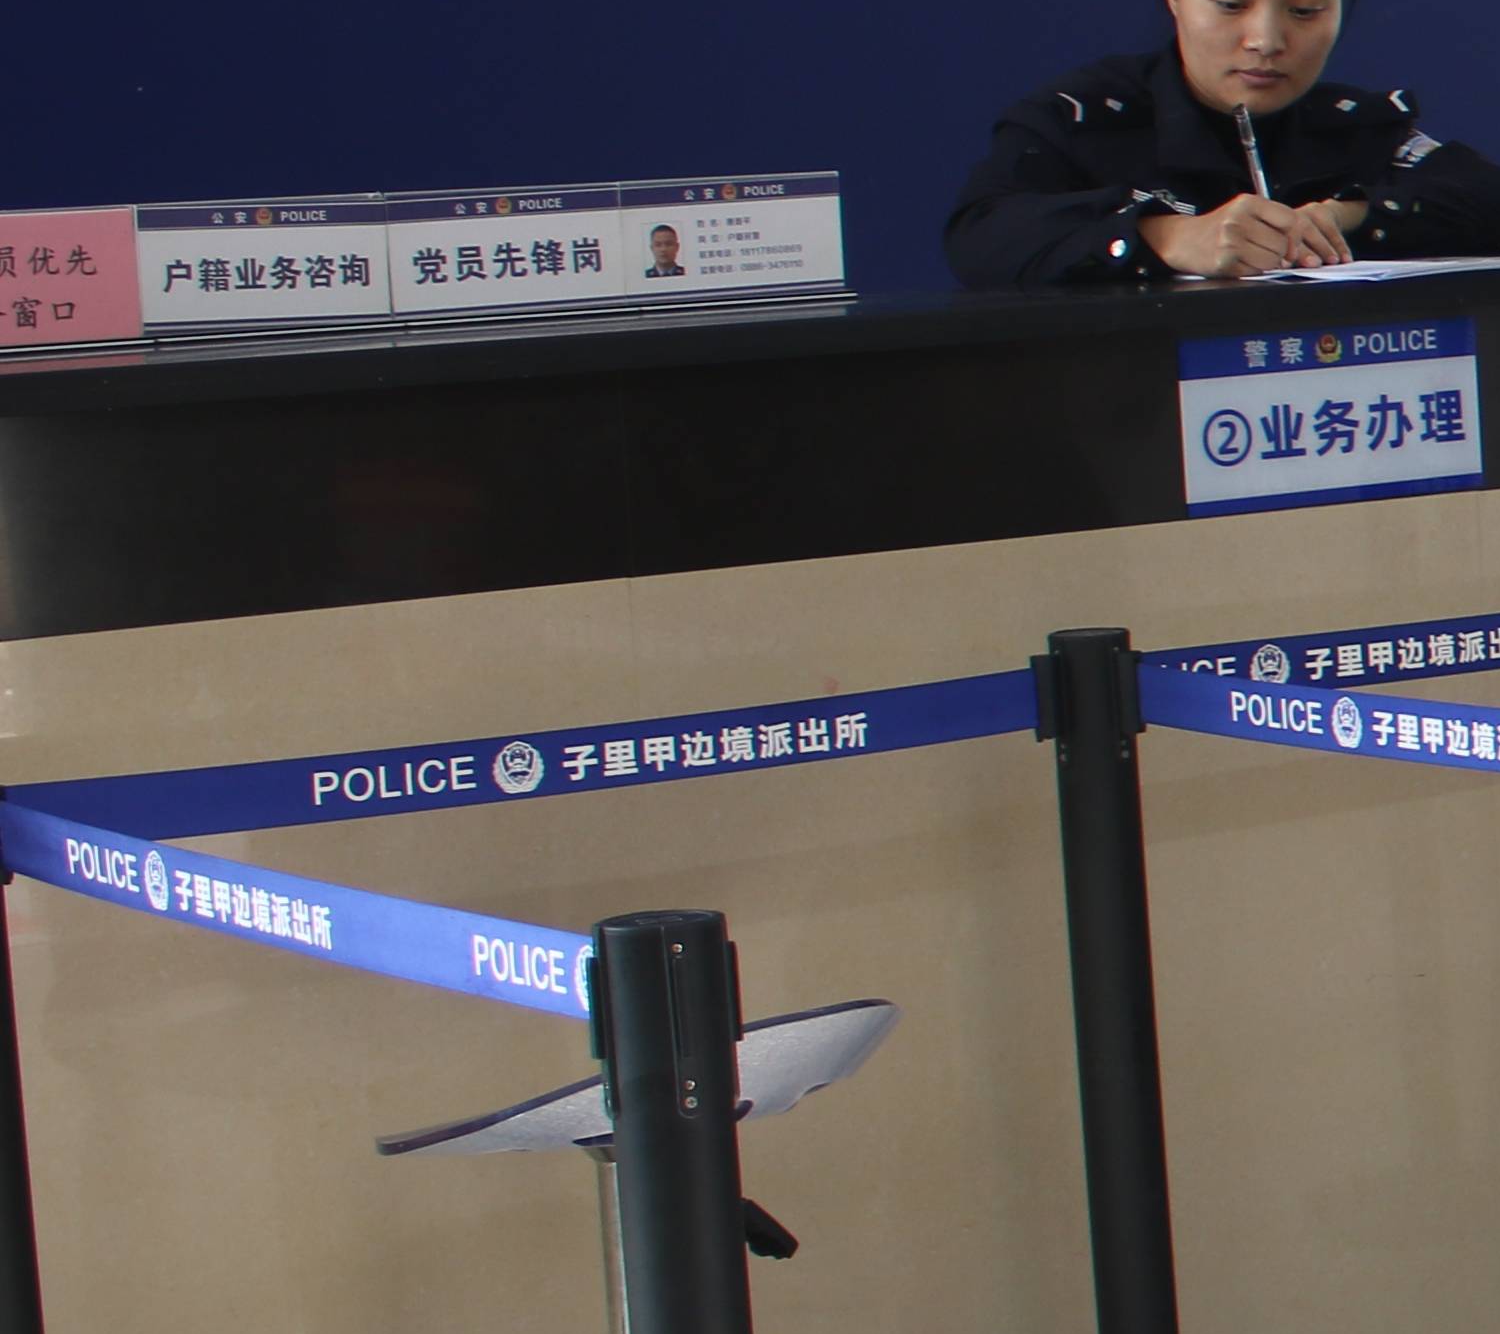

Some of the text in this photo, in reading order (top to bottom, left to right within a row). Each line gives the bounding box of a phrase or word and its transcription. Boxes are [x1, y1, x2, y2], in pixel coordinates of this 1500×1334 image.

[518, 197, 562, 210] POLICE
[744, 184, 784, 196] POLICE
[280, 209, 327, 222] POLICE
[163, 253, 372, 294] 户籍业务咨询
[412, 237, 602, 285] 党员先锋岗
[0, 297, 76, 329] 窗口
[1243, 328, 1438, 369] 警察 POLICE
[1230, 689, 1324, 735] POLICE
[311, 711, 868, 807] POLICE 子里甲边境派出所
[66, 837, 332, 952] POLICE 子里甲边境派出所
[472, 934, 567, 997] POLICE
